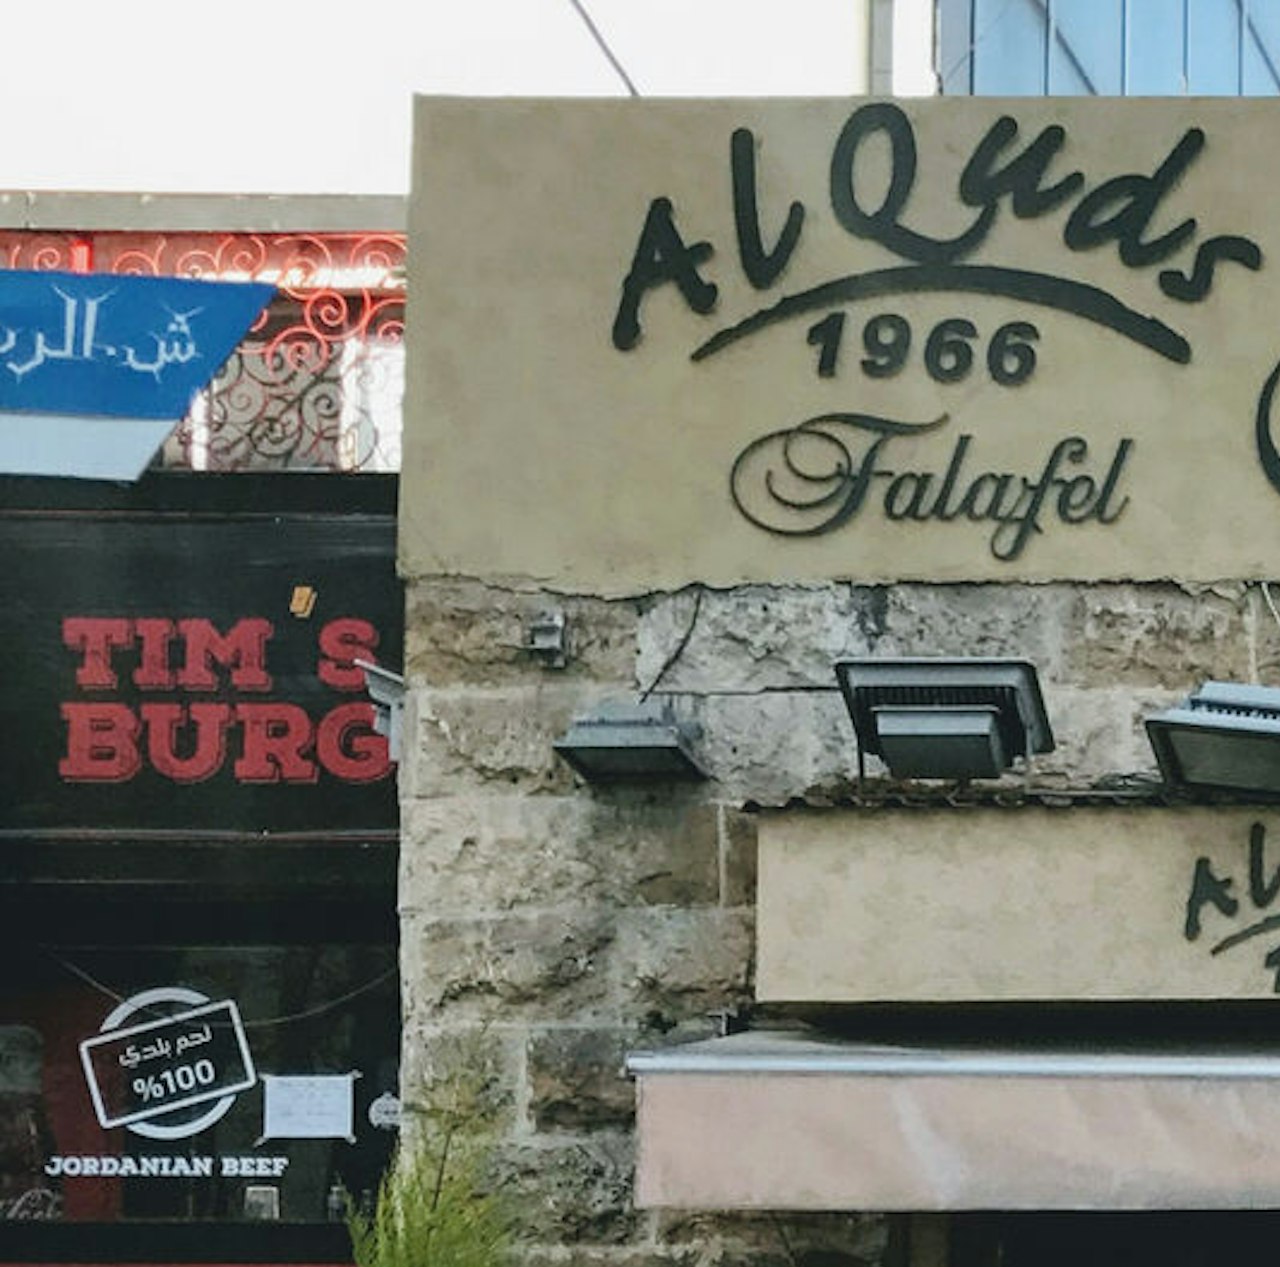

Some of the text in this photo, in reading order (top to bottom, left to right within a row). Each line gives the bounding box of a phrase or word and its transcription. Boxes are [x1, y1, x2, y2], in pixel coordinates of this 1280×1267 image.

[806, 311, 1040, 386] 1966
[730, 412, 1134, 561] Falafel
[61, 586, 379, 692] TIM'S
[44, 1155, 290, 1177] JORDANIAN BEEF
